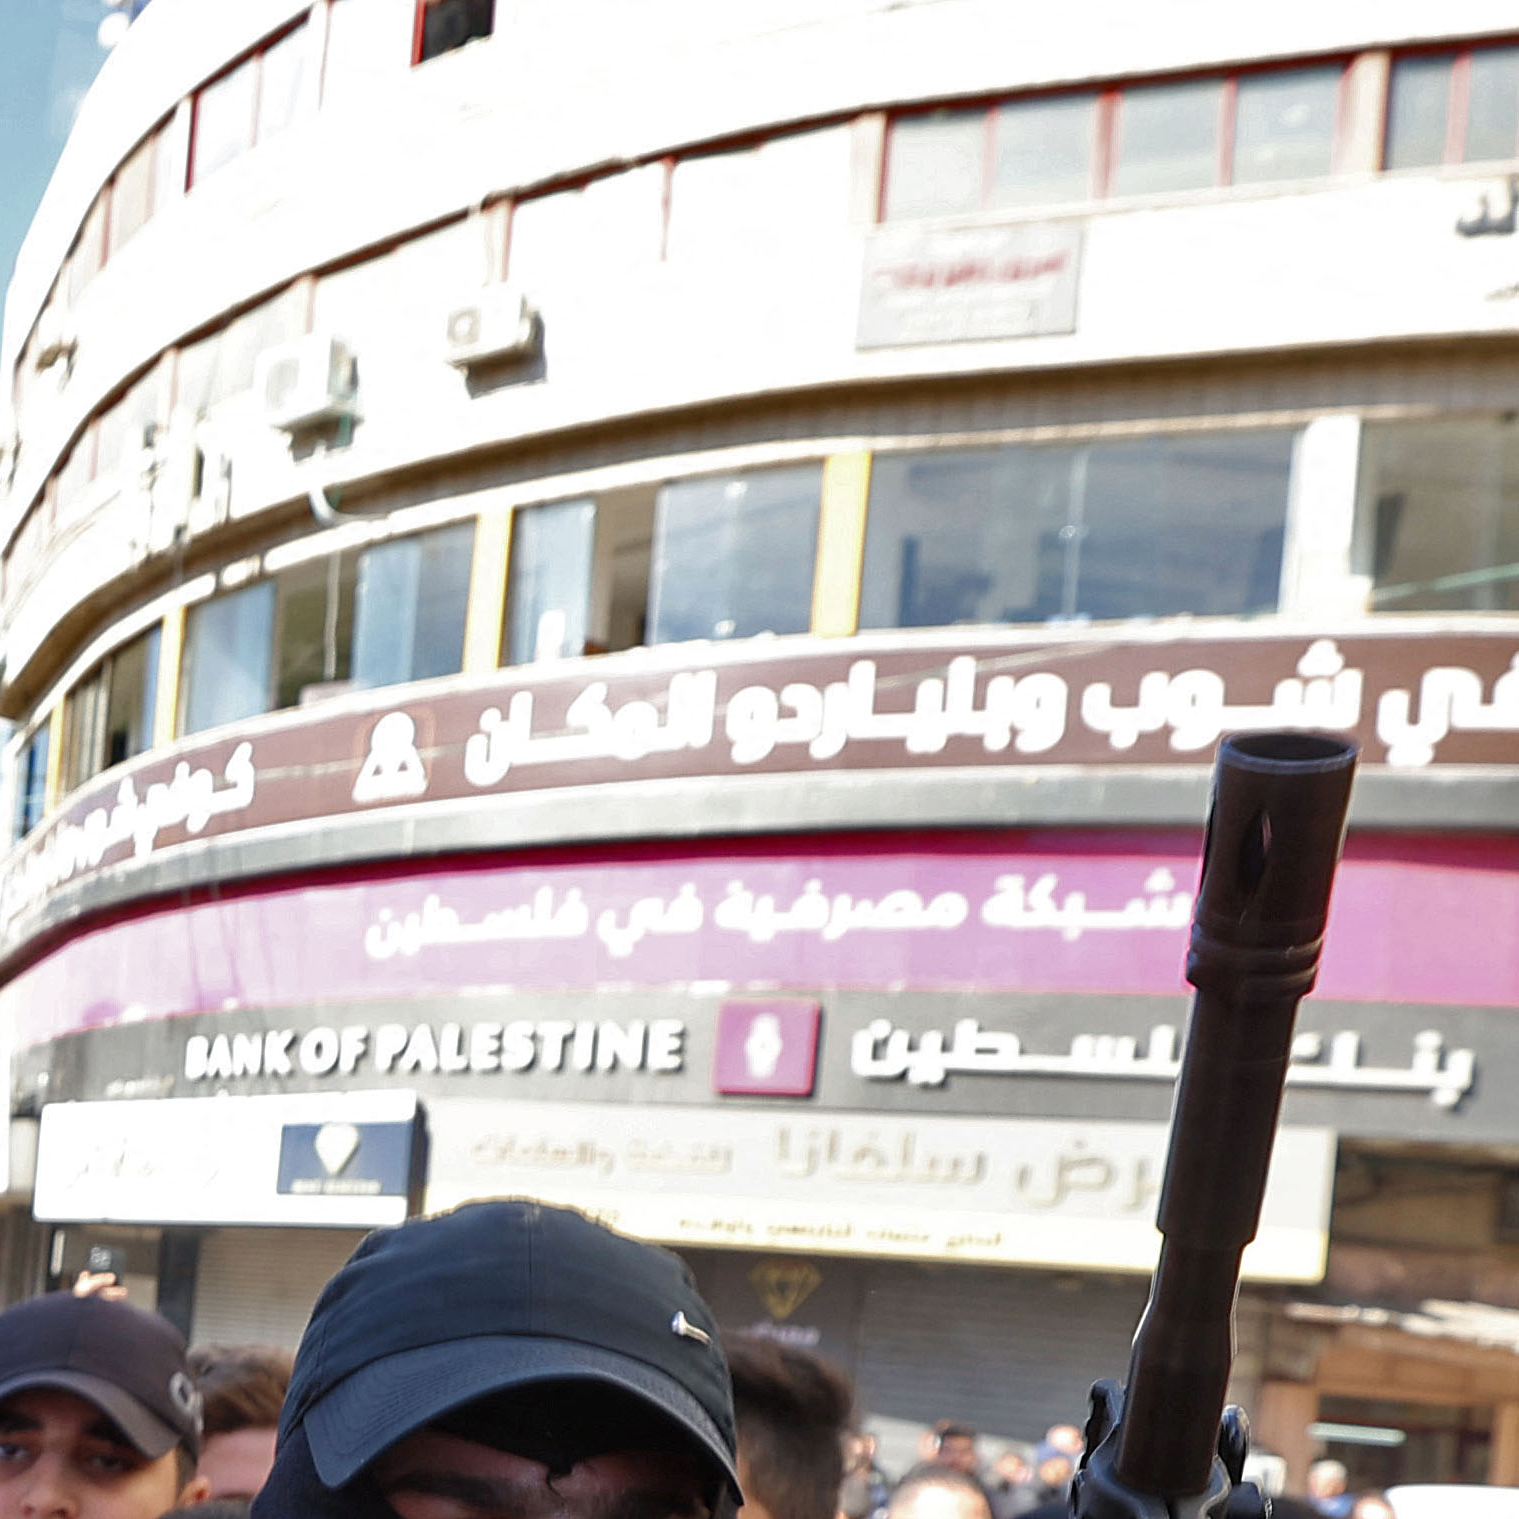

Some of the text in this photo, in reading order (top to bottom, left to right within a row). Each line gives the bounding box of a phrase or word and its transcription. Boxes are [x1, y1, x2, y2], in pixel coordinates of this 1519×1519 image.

[464, 669, 717, 786] المكان
[725, 654, 1068, 765] وبلياردو
[1081, 638, 1363, 751] شوب
[364, 866, 1194, 960] شبكة مصرفية في فلسطين
[183, 1018, 687, 1079] BANK OF PALESTINE
[851, 1017, 1184, 1086] لسطين
